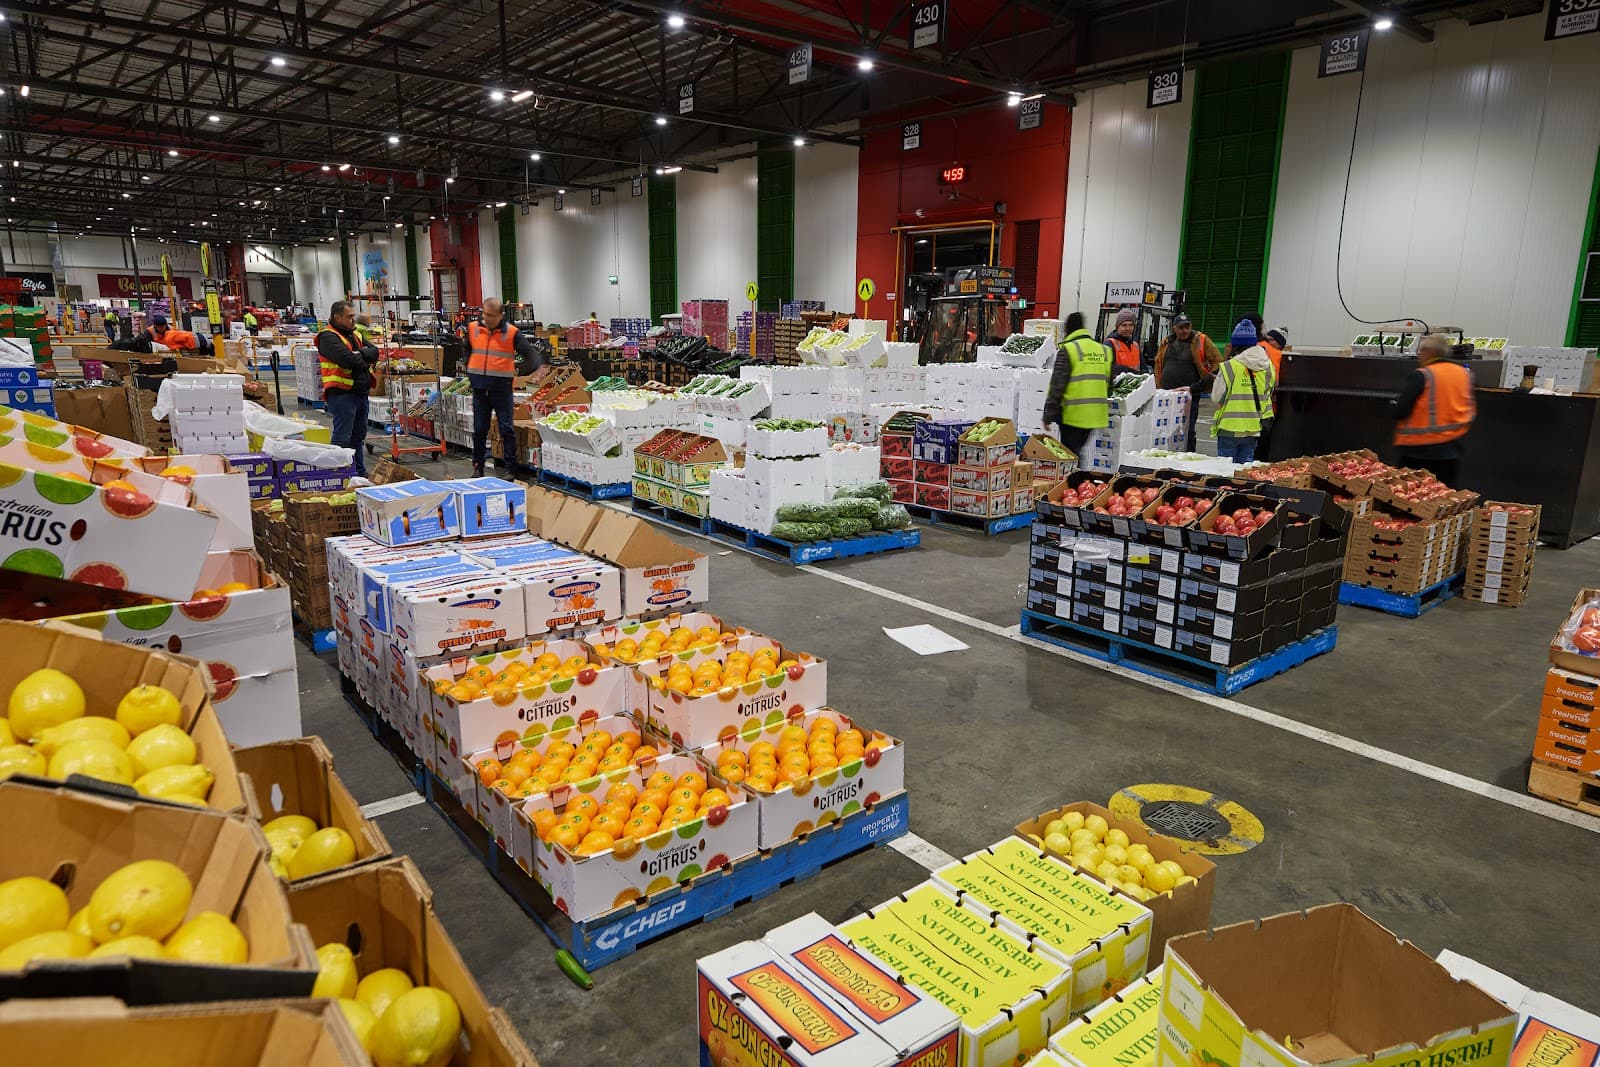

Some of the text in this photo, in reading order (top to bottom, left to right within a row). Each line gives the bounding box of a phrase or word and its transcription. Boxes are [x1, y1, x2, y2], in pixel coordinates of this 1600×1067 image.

[915, 4, 939, 24] 430
[790, 48, 807, 64] 429
[1330, 35, 1359, 54] 331
[679, 83, 693, 97] 428
[1154, 71, 1178, 88] 330
[1021, 100, 1040, 114] 329
[904, 123, 919, 136] 328
[22, 278, 47, 291] Style
[1110, 287, 1141, 297] SA TRAN
[0, 510, 67, 546] RUS
[546, 609, 605, 628] CITRUS FRUITS
[438, 628, 507, 649] CITRUS FRUITS
[744, 695, 781, 717] CITRUS
[1556, 687, 1594, 701] freshmax
[526, 700, 570, 722] CITRUS
[1552, 708, 1590, 723] freshmax
[1549, 730, 1587, 745] freshmax
[1545, 750, 1583, 766] freshmax
[820, 784, 857, 810] CITRUS
[861, 811, 900, 835] PROPERTY
[870, 828, 879, 838] OF
[649, 846, 697, 876] CITRUS
[1006, 862, 1102, 918] AUSTRALIAN
[1016, 849, 1125, 912] FRESH CITRUS
[953, 876, 1065, 946] FRESH CITRUS
[977, 874, 1076, 934] AUSTRALIAN
[623, 900, 687, 936] CHEP
[930, 898, 987, 937] CITRUS
[917, 912, 1017, 980] AUSTRALIAN
[986, 930, 1044, 973] FRESH
[858, 934, 972, 1016] FRESH CITRUS
[883, 931, 985, 999] AUSTRALIAN
[808, 944, 901, 1013] OZ SUN CITRUS
[747, 971, 840, 1044] OZ SUN CITRUS
[706, 988, 729, 1032] OZ
[730, 1012, 757, 1057] SUN
[1080, 1008, 1137, 1050] CITRUS
[1428, 1037, 1496, 1067] FRESH
